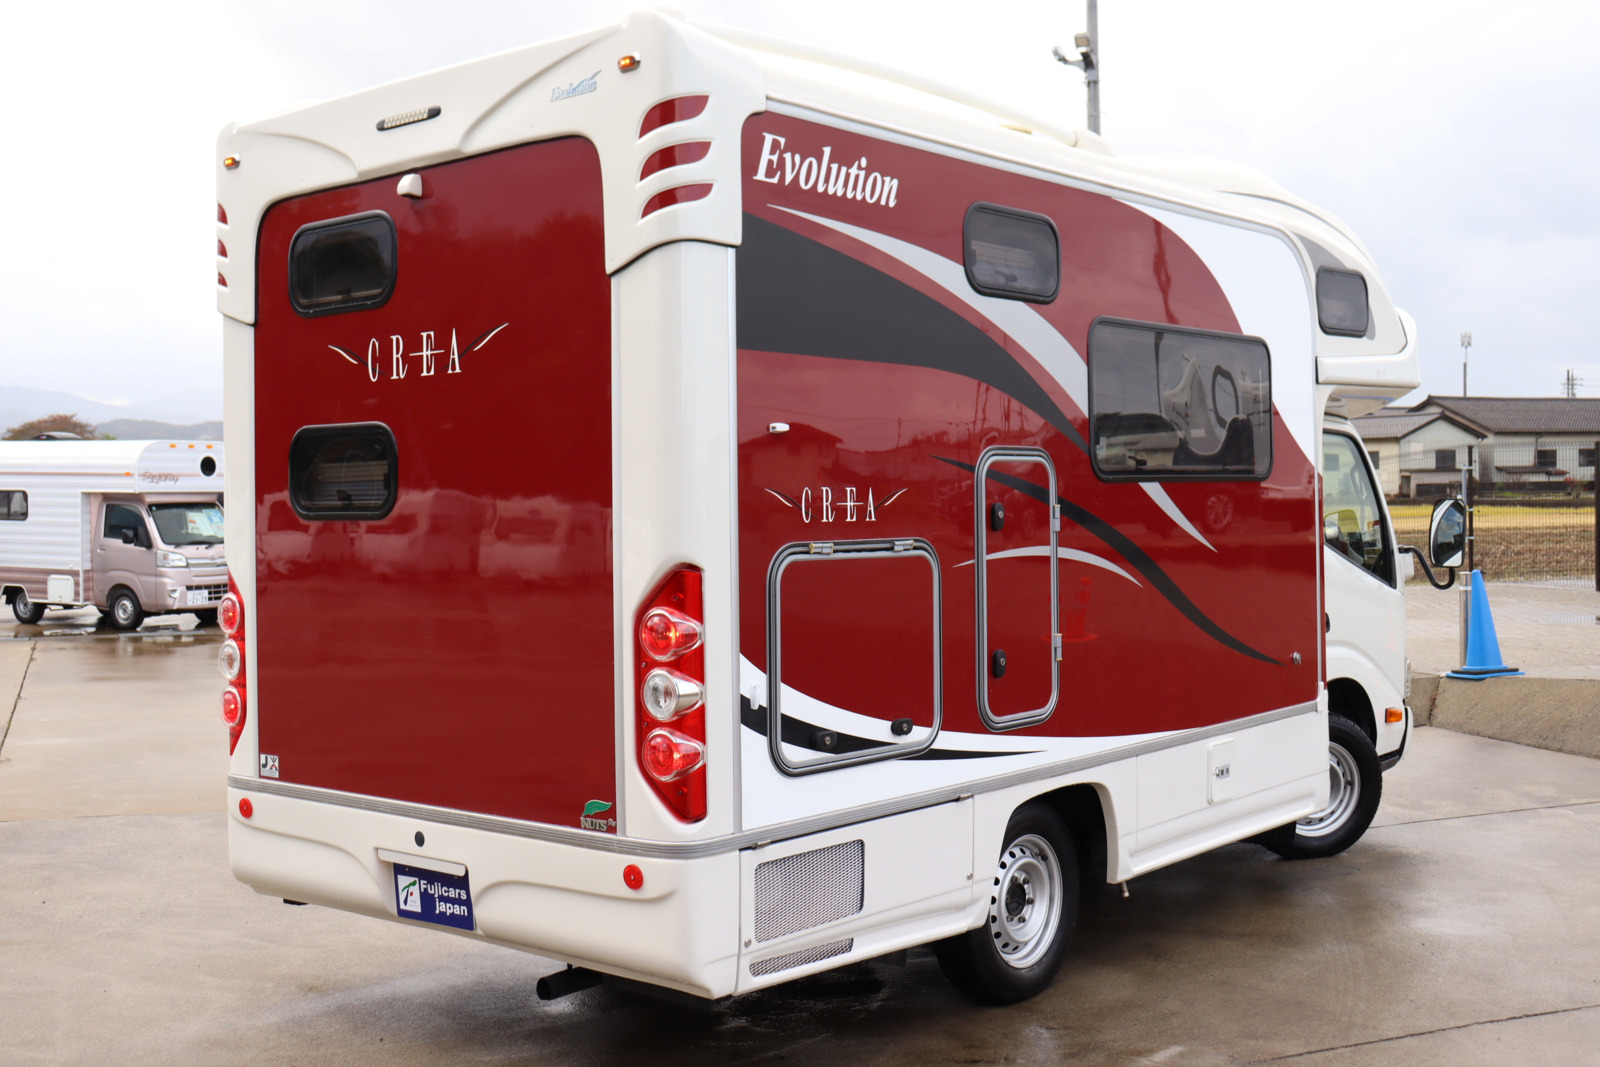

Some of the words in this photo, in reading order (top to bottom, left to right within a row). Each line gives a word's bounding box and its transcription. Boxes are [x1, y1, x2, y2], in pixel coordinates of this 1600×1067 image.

[550, 80, 597, 102] Evolution
[752, 132, 899, 208] Evolution
[368, 327, 462, 383] CREA
[802, 486, 877, 524] CREA
[580, 816, 608, 831] NUTS
[420, 879, 467, 900] Fujicars
[435, 898, 468, 916] japan
